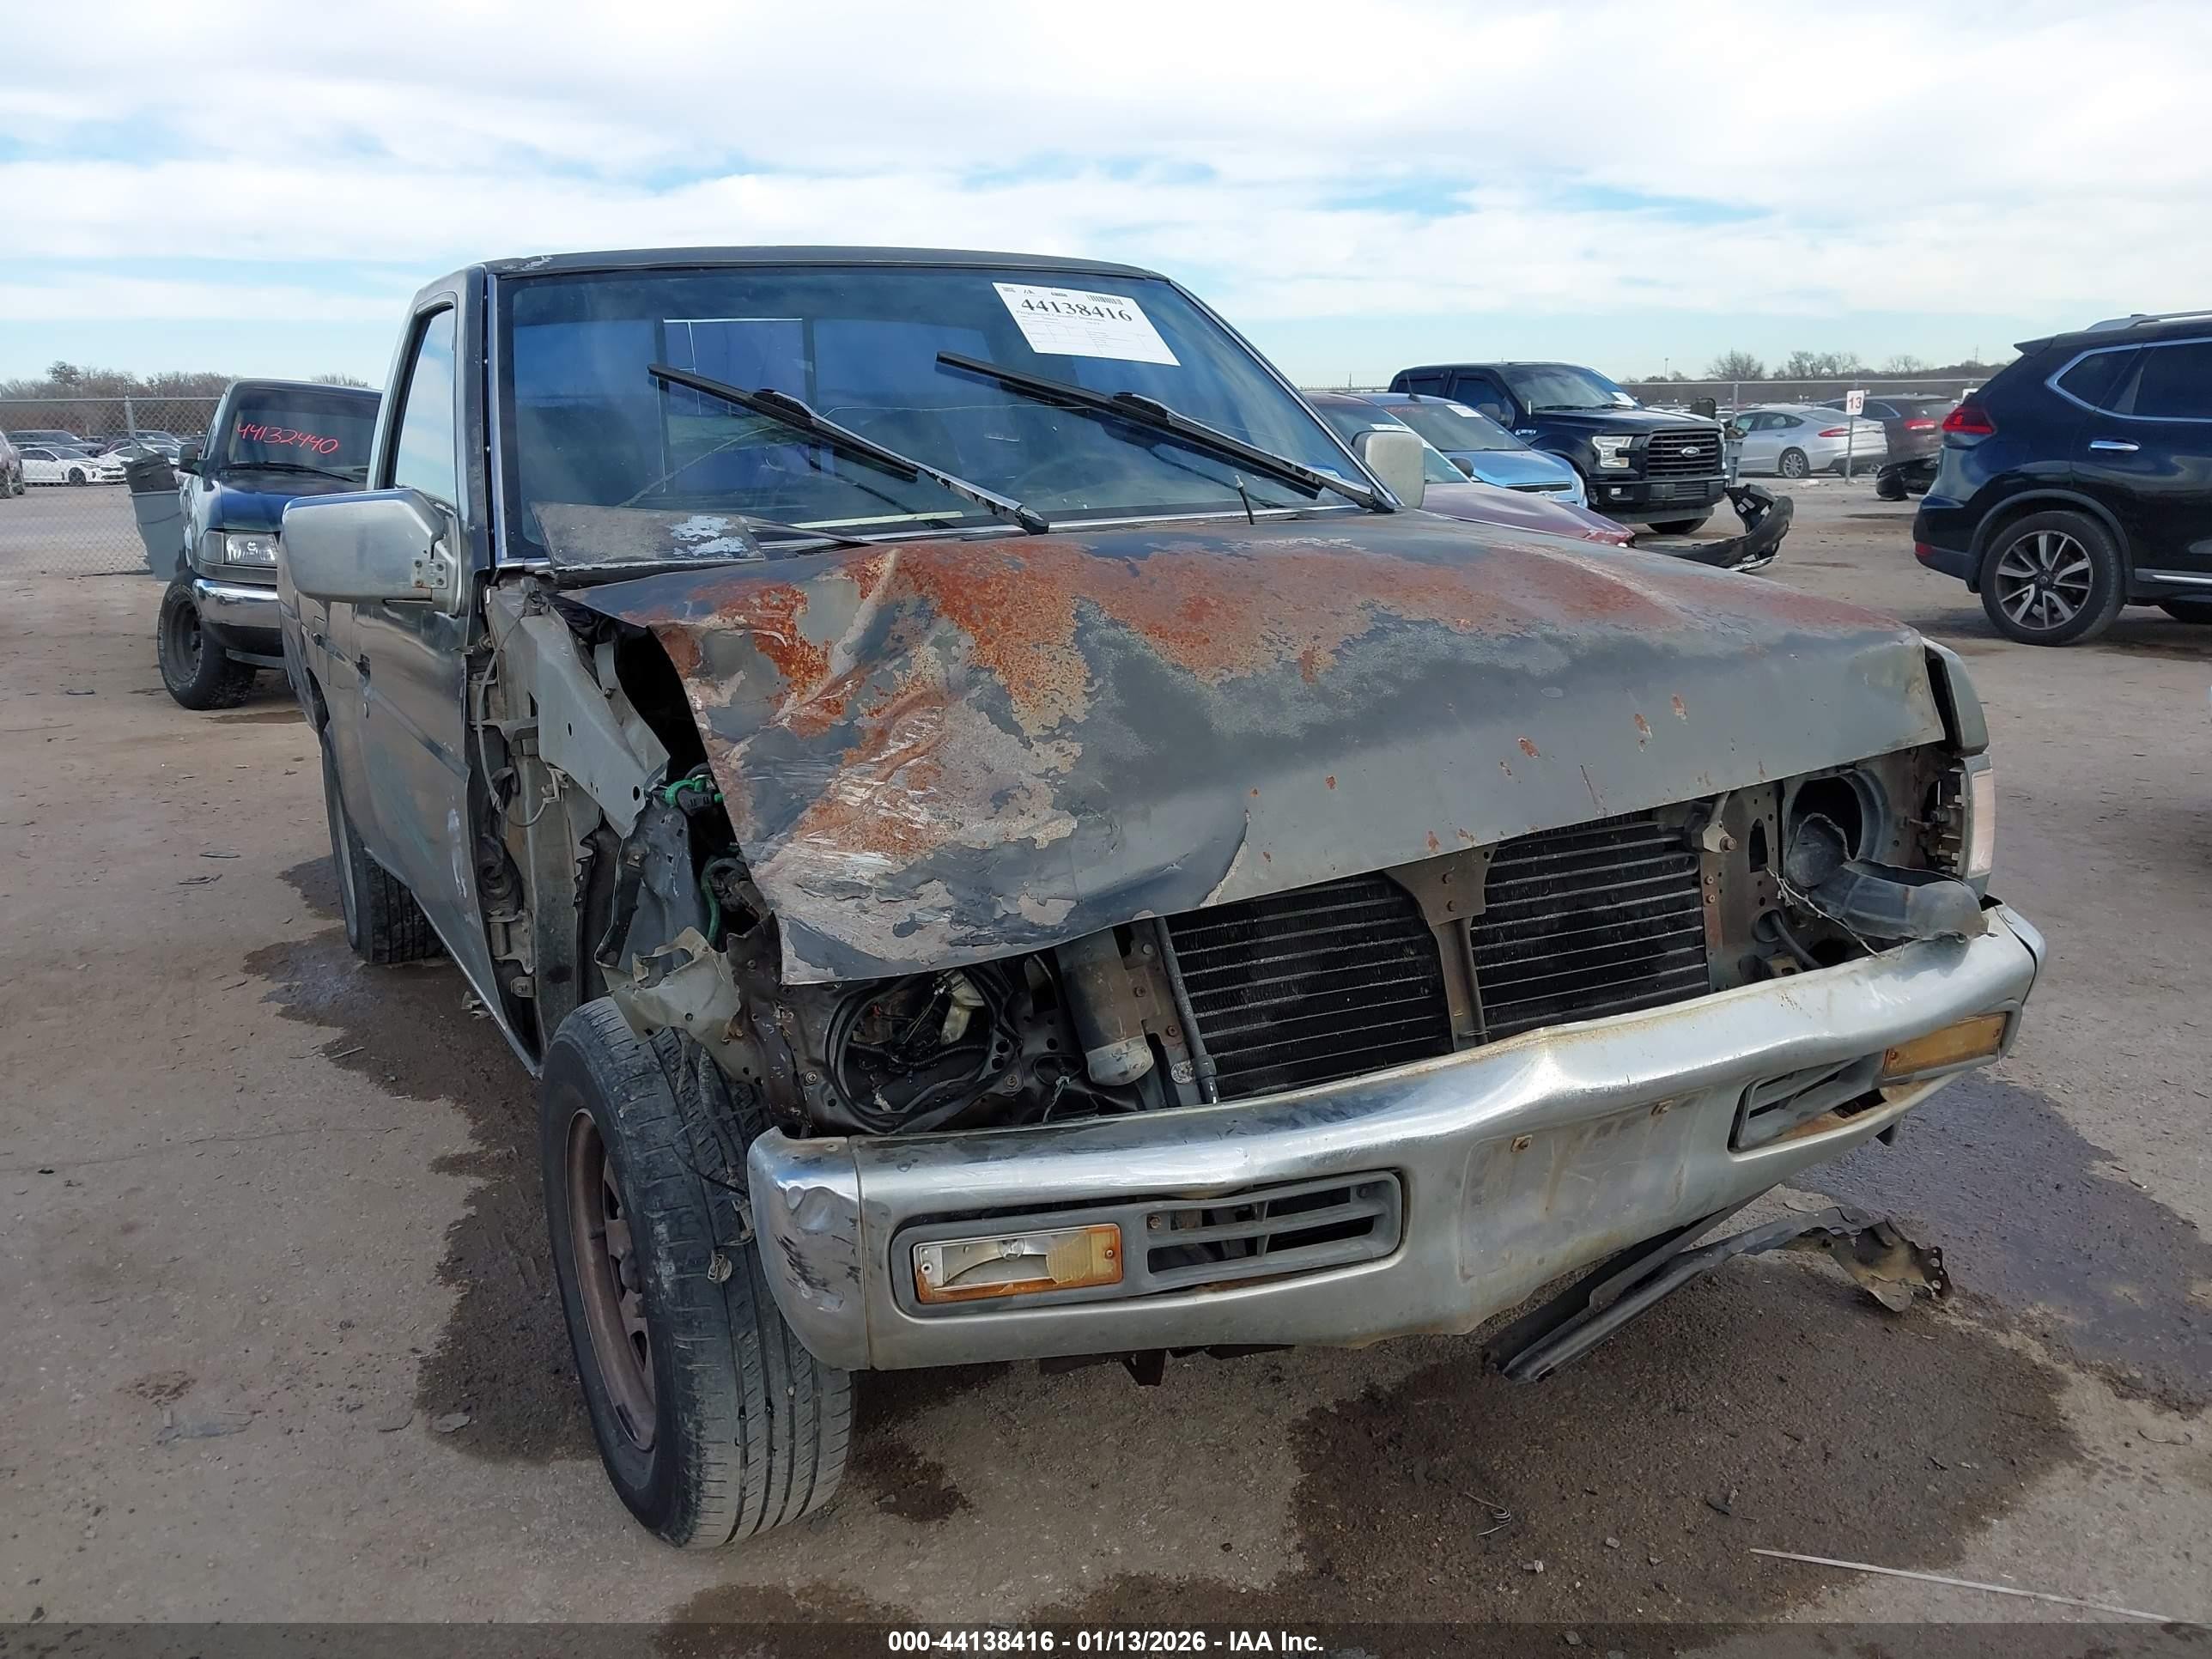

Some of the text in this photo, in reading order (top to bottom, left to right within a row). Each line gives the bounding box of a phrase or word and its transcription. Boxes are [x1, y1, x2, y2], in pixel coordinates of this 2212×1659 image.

[1021, 298, 1133, 322] 44138416
[1849, 397, 1862, 409] 13
[237, 422, 340, 453] 44132440
